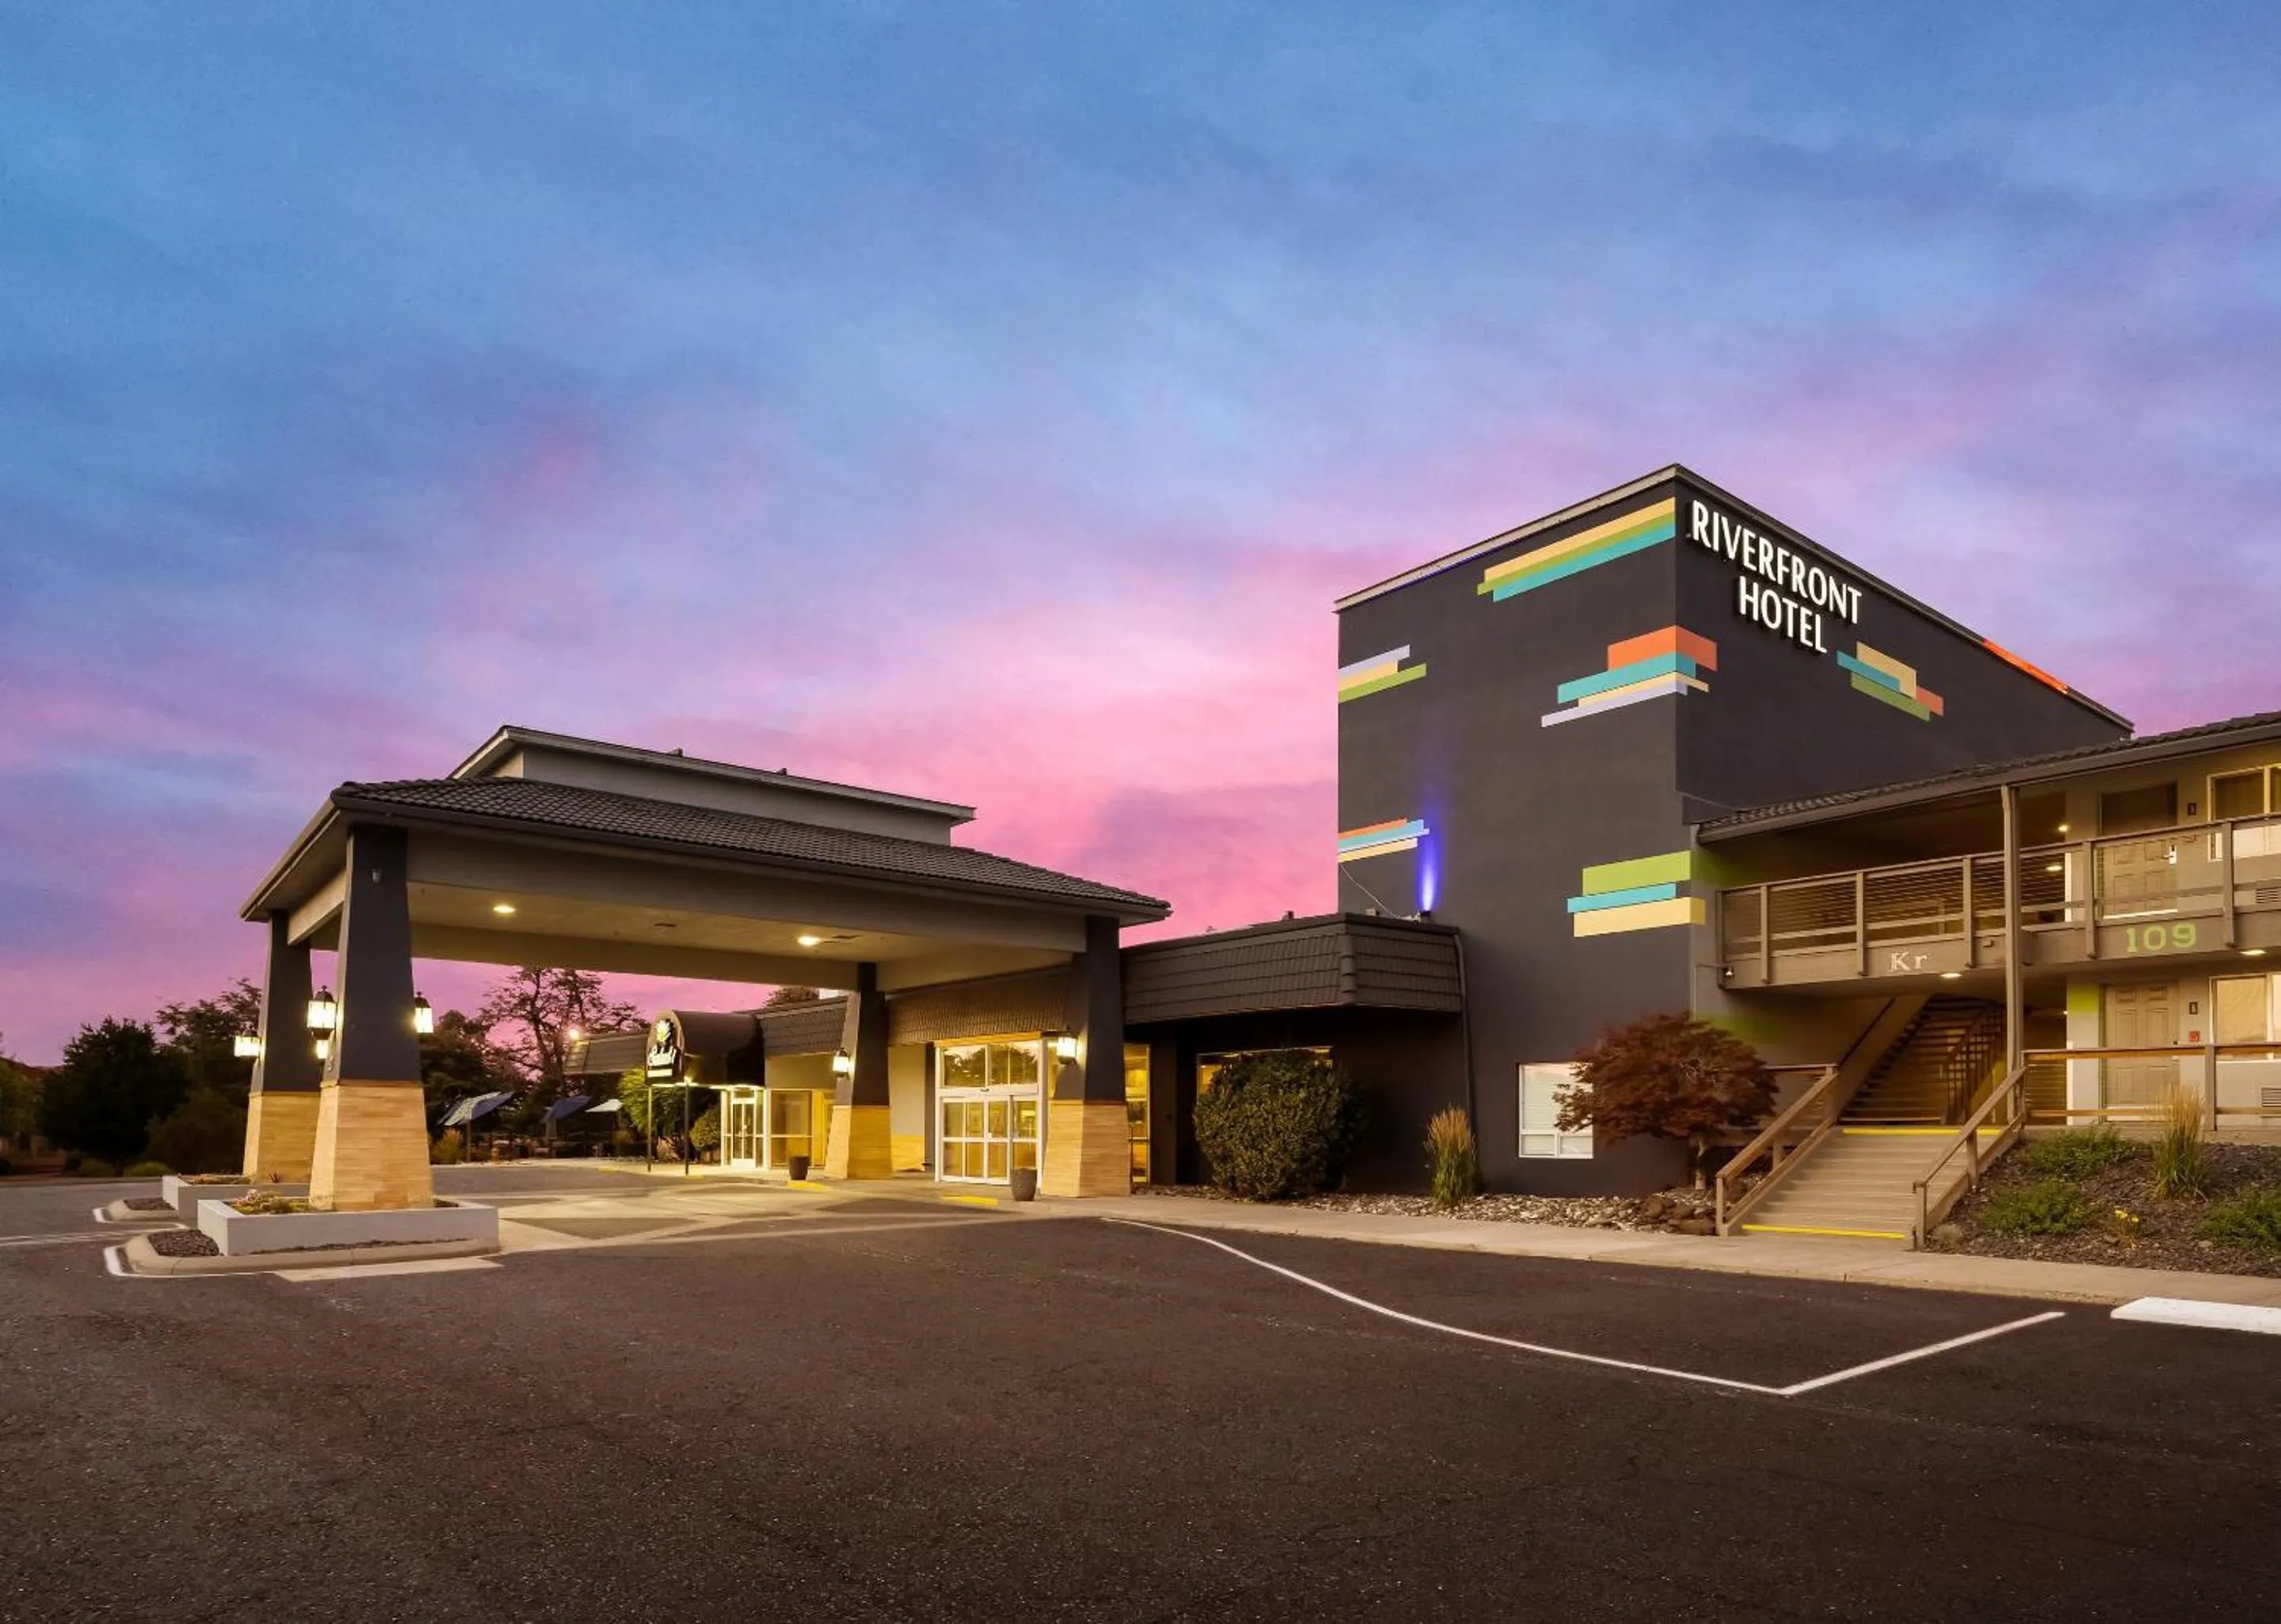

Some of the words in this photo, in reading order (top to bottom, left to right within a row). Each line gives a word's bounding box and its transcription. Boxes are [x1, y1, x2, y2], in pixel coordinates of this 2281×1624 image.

[1692, 500, 1862, 624] RIVERFRONT
[1739, 576, 1827, 654] HOTEL
[1889, 951, 1928, 972] Kr
[2126, 923, 2197, 954] 109
